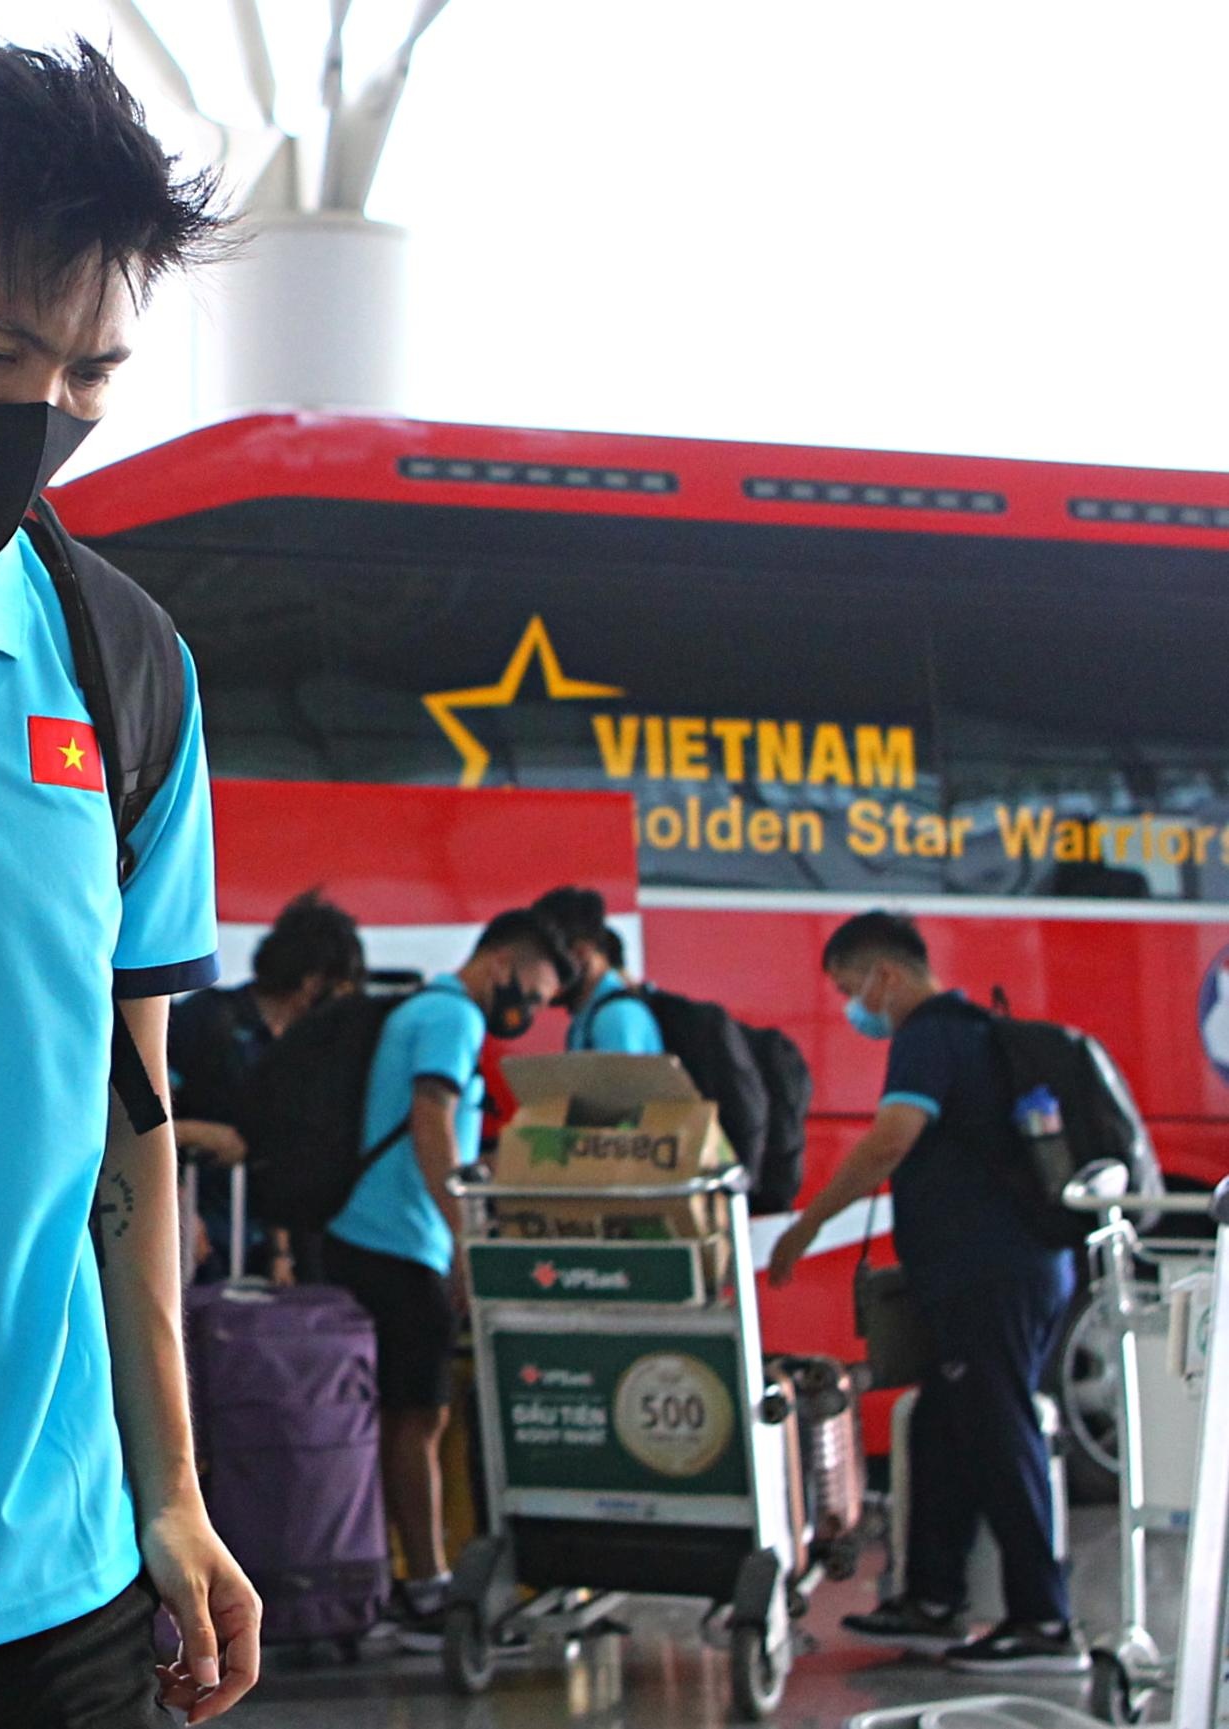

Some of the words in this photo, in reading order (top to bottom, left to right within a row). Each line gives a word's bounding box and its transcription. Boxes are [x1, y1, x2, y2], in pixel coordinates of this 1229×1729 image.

[591, 714, 915, 790] VIETNAM
[633, 794, 821, 855] olden
[846, 798, 973, 859] Star
[640, 1395, 705, 1430] 500
